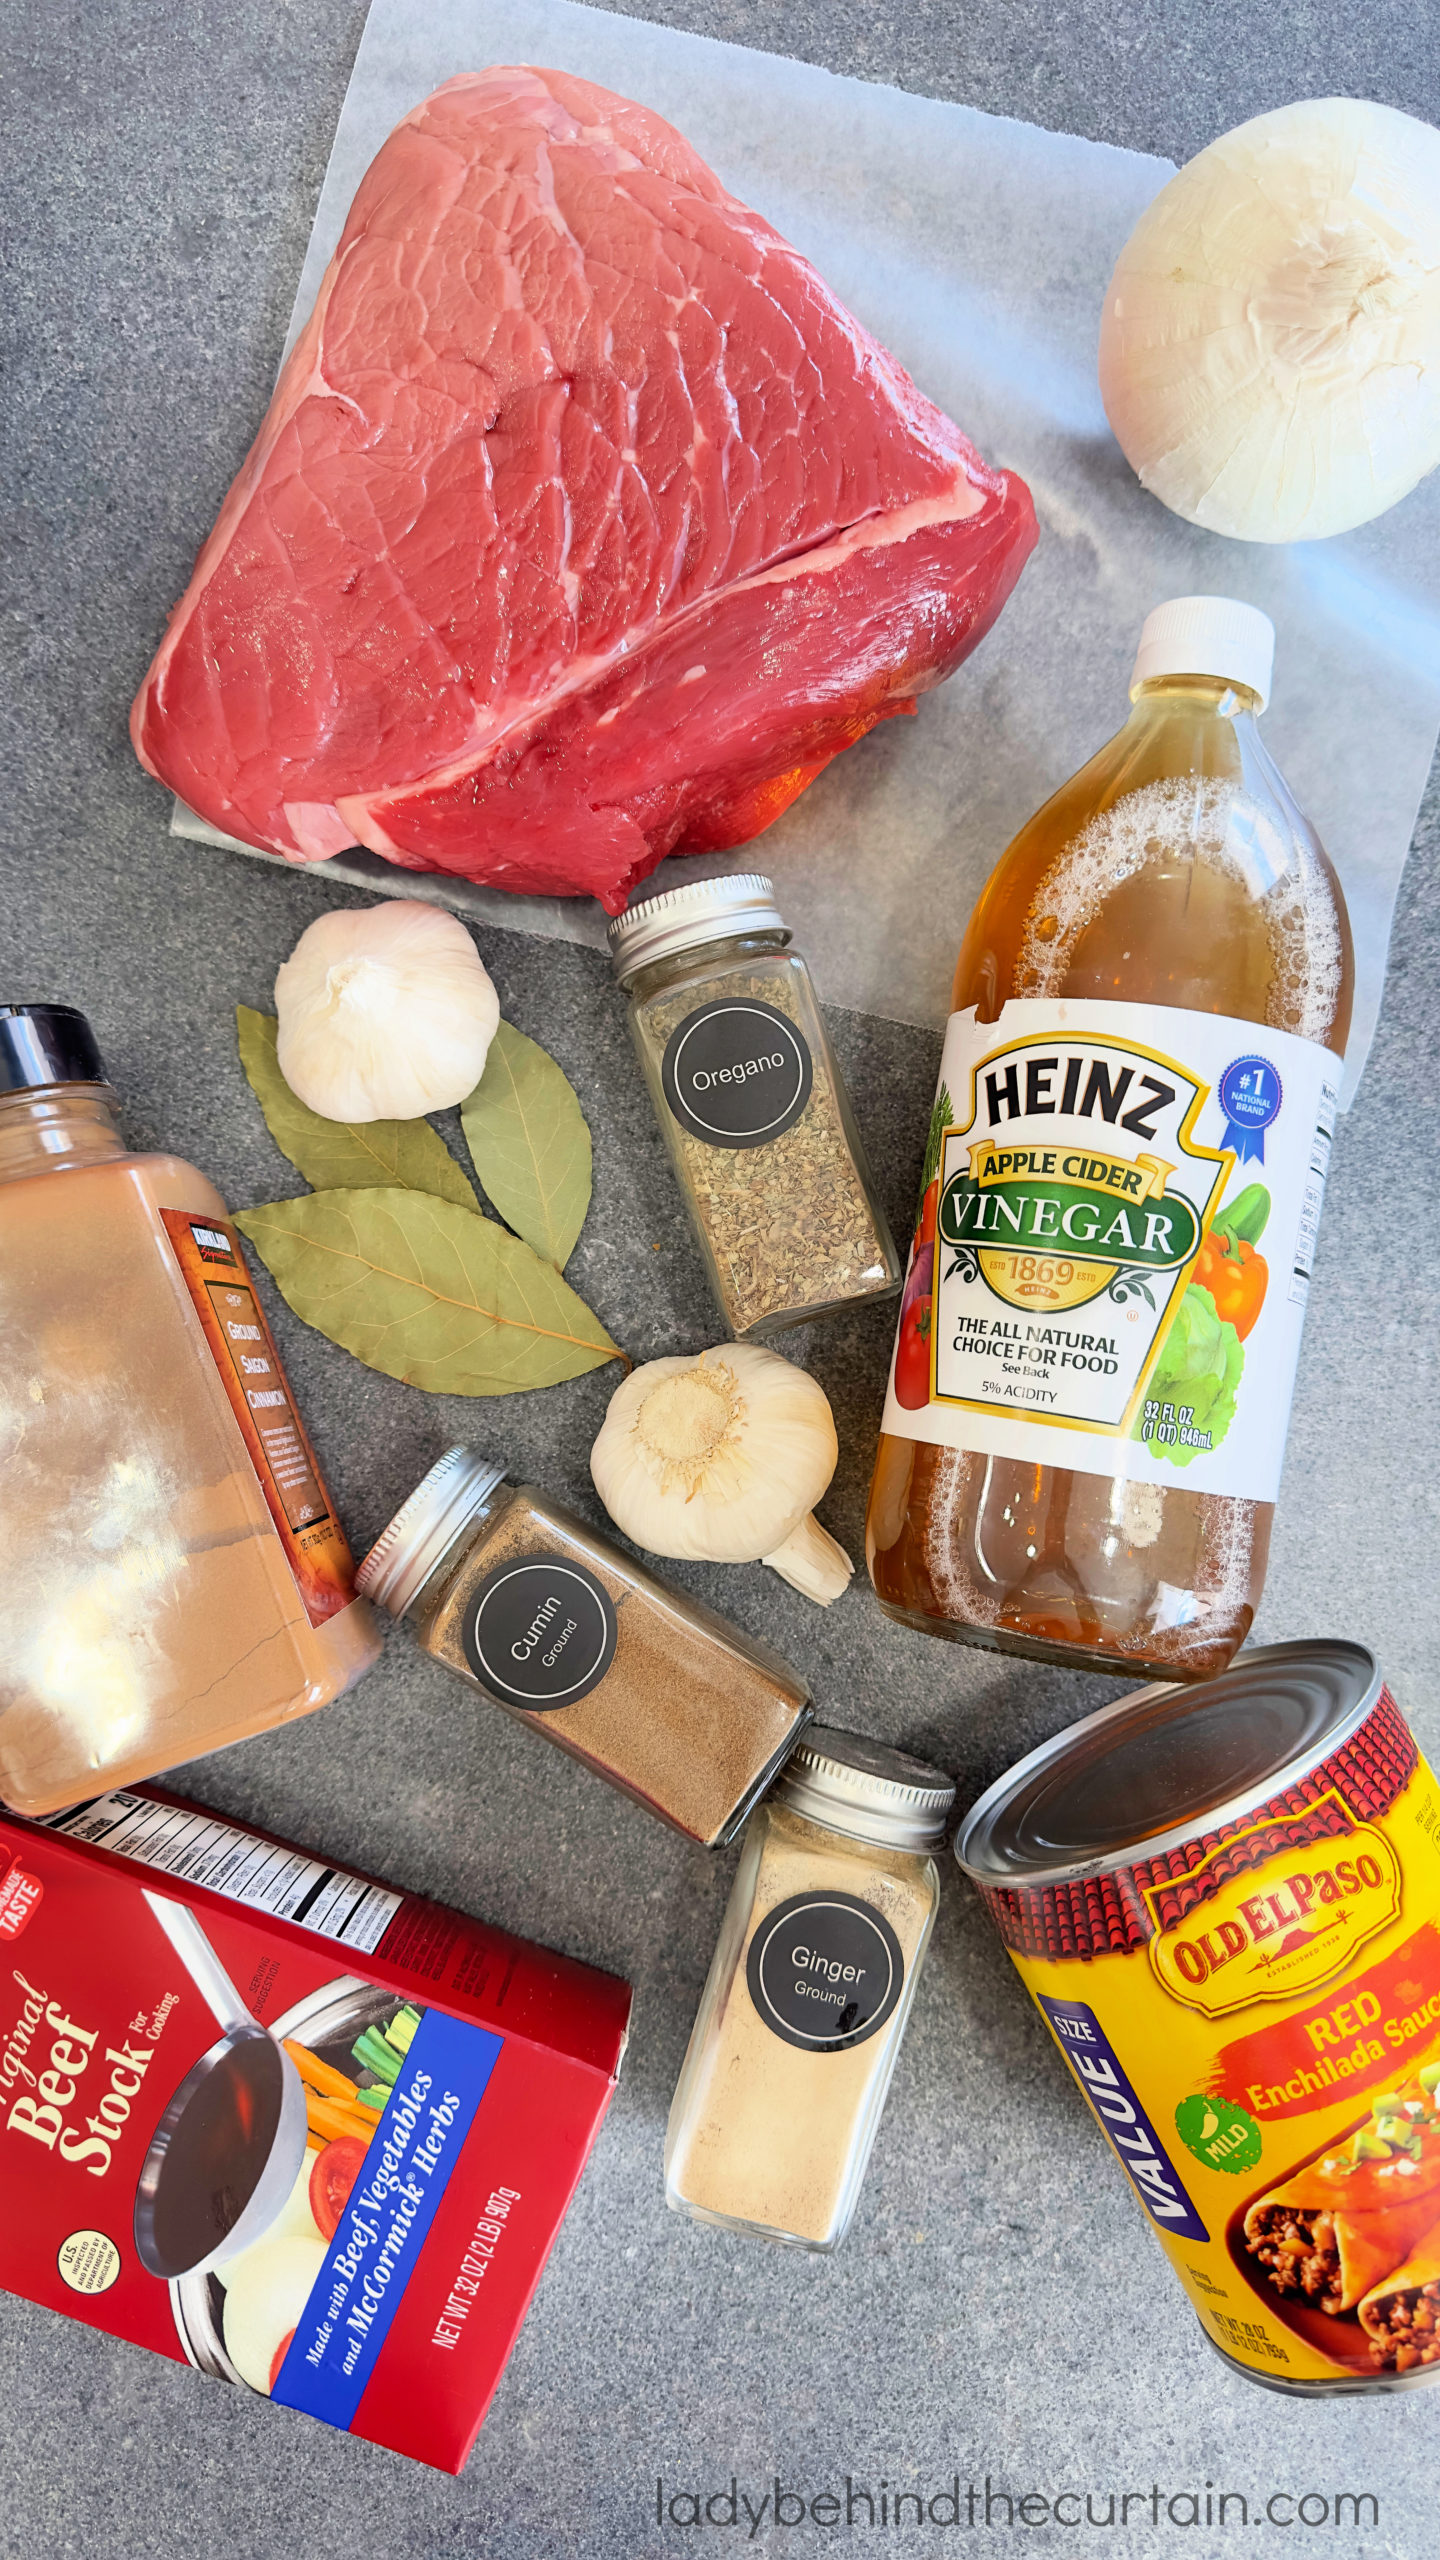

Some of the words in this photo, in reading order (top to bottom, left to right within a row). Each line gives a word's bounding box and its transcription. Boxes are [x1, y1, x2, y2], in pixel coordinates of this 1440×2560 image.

[692, 1052, 785, 1091] Oregano
[1239, 1069, 1265, 1096] #1
[984, 1057, 1176, 1141] HEINZ
[1231, 1092, 1271, 1109] NATIONAL
[1235, 1102, 1265, 1116] BRAND
[982, 1152, 1057, 1178] APPLE
[1062, 1155, 1143, 1196] CIDER
[951, 1193, 1175, 1255] VINEGAR
[989, 1261, 1006, 1271] ESTD
[1007, 1255, 1074, 1286] 1869
[1076, 1272, 1096, 1282] ESTD
[1024, 1286, 1051, 1297] HEINZ
[958, 1317, 988, 1334] THE
[990, 1321, 1022, 1340] ALL
[1026, 1326, 1120, 1355] NATURAL
[952, 1336, 1015, 1359] CHOICE
[1017, 1345, 1056, 1365] FOR
[1060, 1352, 1118, 1375] FOOD
[1001, 1362, 1021, 1374] See
[1023, 1365, 1050, 1379] Back
[981, 1380, 1001, 1394] 5%
[1004, 1384, 1058, 1403] ACIDITY
[1144, 1400, 1160, 1420] 32
[1161, 1402, 1175, 1422] FL
[1178, 1405, 1194, 1425] OZ
[1142, 1420, 1155, 1442] (1
[1157, 1422, 1177, 1446] QT)
[1179, 1426, 1213, 1449] 946mL
[511, 1596, 562, 1661] Cumin
[542, 1618, 578, 1667] Ground
[72, 1817, 114, 1840] Calories
[108, 1793, 138, 1809] 20
[0, 1869, 24, 1914] EMADE
[0, 1879, 40, 1933] TASTE
[1172, 1920, 1249, 1986] OLD
[1236, 1892, 1300, 1944] EL
[249, 1956, 271, 1993] SERVING
[791, 1946, 866, 1984] Ginger
[1267, 1947, 1319, 1978] ESTABLISHED
[252, 1961, 280, 2014] SUGGESTION
[794, 1980, 847, 2006] Ground
[128, 2011, 148, 2034] For
[146, 1992, 180, 2040] Cooking
[1054, 2015, 1097, 2042] SIZE
[1303, 1991, 1381, 2052] RED
[0, 1969, 48, 2105] iginal
[1245, 2039, 1386, 2111] Enchilada
[1383, 1992, 1440, 2047] Sauc
[6, 2001, 99, 2151] Beef
[59, 2039, 155, 2177] Stock
[358, 2070, 432, 2212] Vegetables
[1070, 2050, 1189, 2217] VALUE
[1205, 2123, 1249, 2163] MILD
[484, 2186, 522, 2220] 907g
[332, 2210, 381, 2284] Beef,
[341, 2336, 363, 2376] and
[410, 2090, 460, 2177] Herbs
[468, 2240, 495, 2258] (2
[474, 2216, 507, 2244] LB)
[62, 2245, 78, 2264] U.S.
[72, 2241, 89, 2275] INSPECTED
[78, 2272, 87, 2286] AND
[83, 2247, 97, 2272] PASSED
[93, 2237, 100, 2247] BY
[85, 2250, 105, 2289] DEPARTMENT
[102, 2241, 108, 2250] OF
[96, 2250, 116, 2288] AGRICULTURE
[460, 2254, 488, 2278] OZ
[327, 2281, 349, 2321] with
[454, 2275, 480, 2296] 32
[442, 2291, 473, 2320] WT
[305, 2321, 334, 2368] Made
[431, 2316, 462, 2350] NET
[1252, 2324, 1270, 2341] OZ
